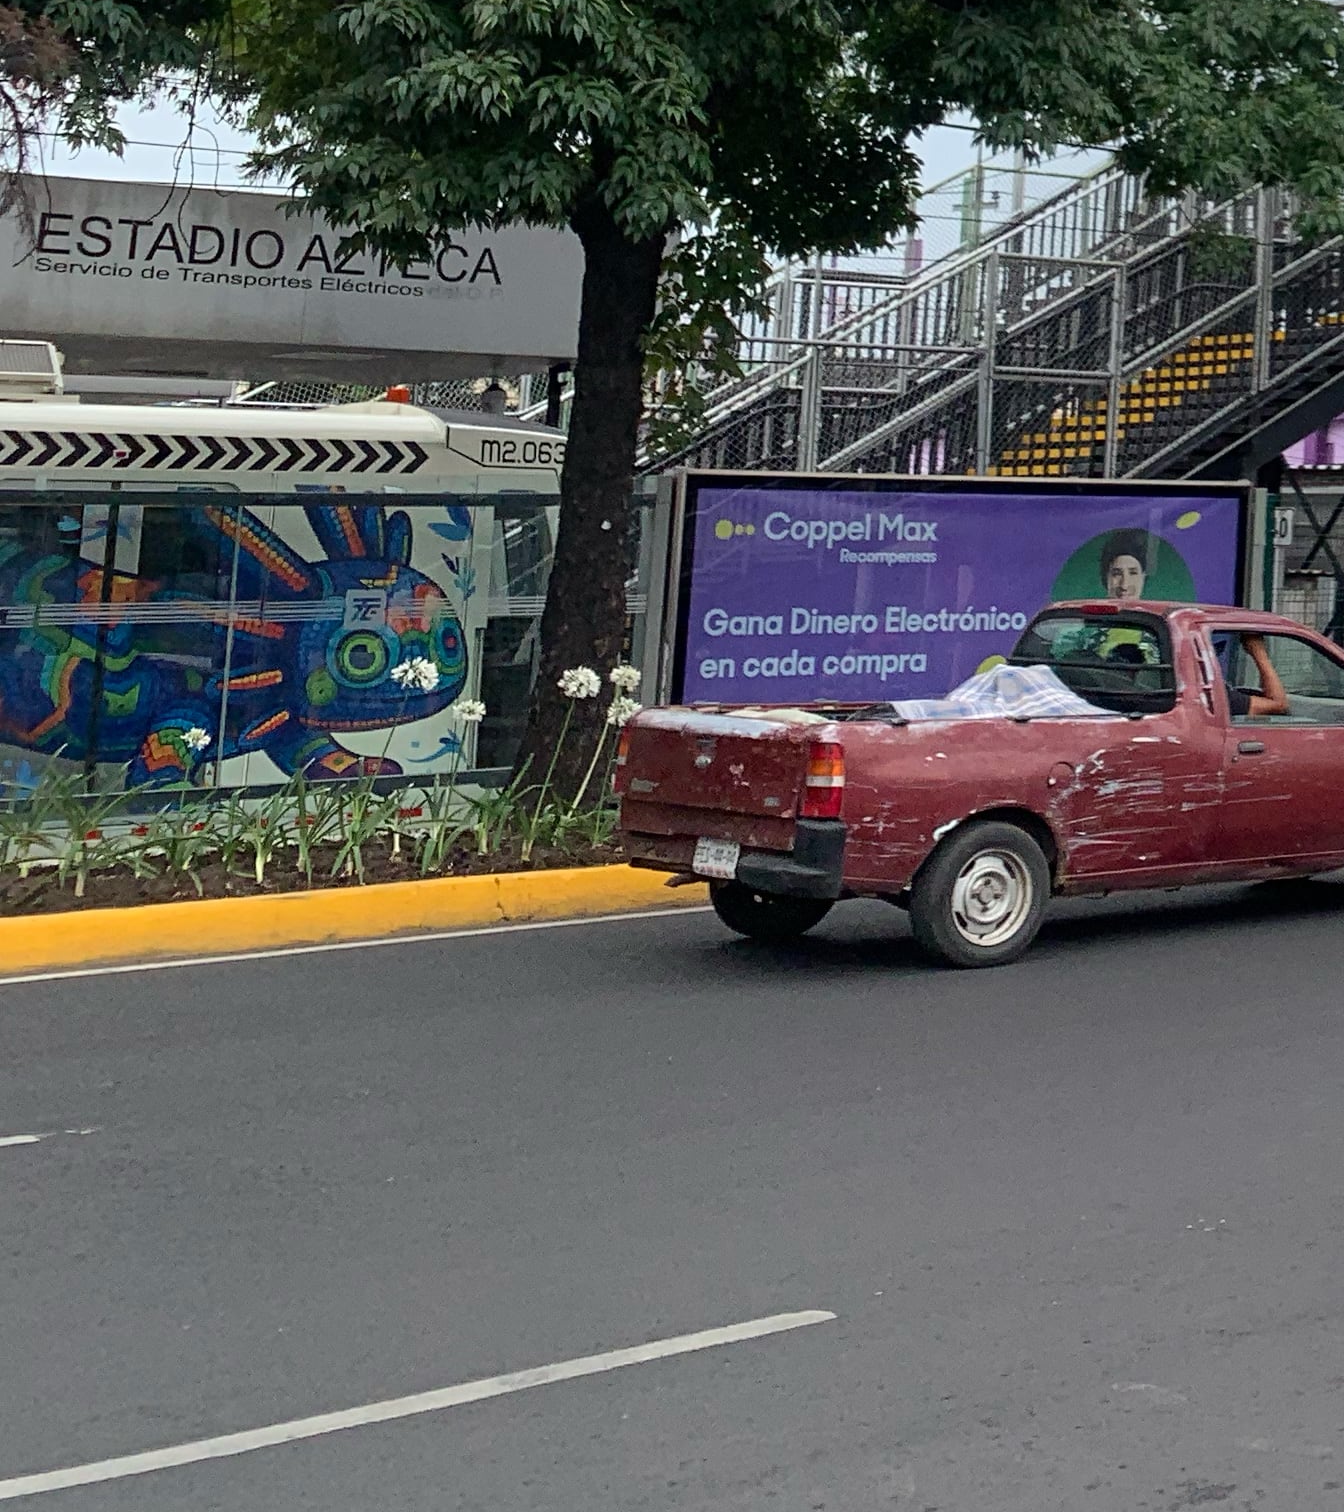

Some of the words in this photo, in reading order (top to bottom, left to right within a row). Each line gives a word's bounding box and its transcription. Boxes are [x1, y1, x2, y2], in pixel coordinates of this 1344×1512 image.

[36, 211, 285, 270] ESTADIO
[34, 257, 133, 278] Servicio
[141, 266, 170, 280] de
[178, 267, 313, 289] Transportes
[320, 276, 424, 297] Eléctricos
[763, 511, 871, 549] Coppel
[878, 513, 938, 541] Max
[839, 548, 938, 566] Recompensas
[703, 608, 783, 637] Gana
[790, 607, 878, 635] Dinero
[884, 605, 1027, 633] Electrónico
[700, 657, 735, 679] en
[743, 649, 815, 678] cada
[822, 653, 927, 681] compra
